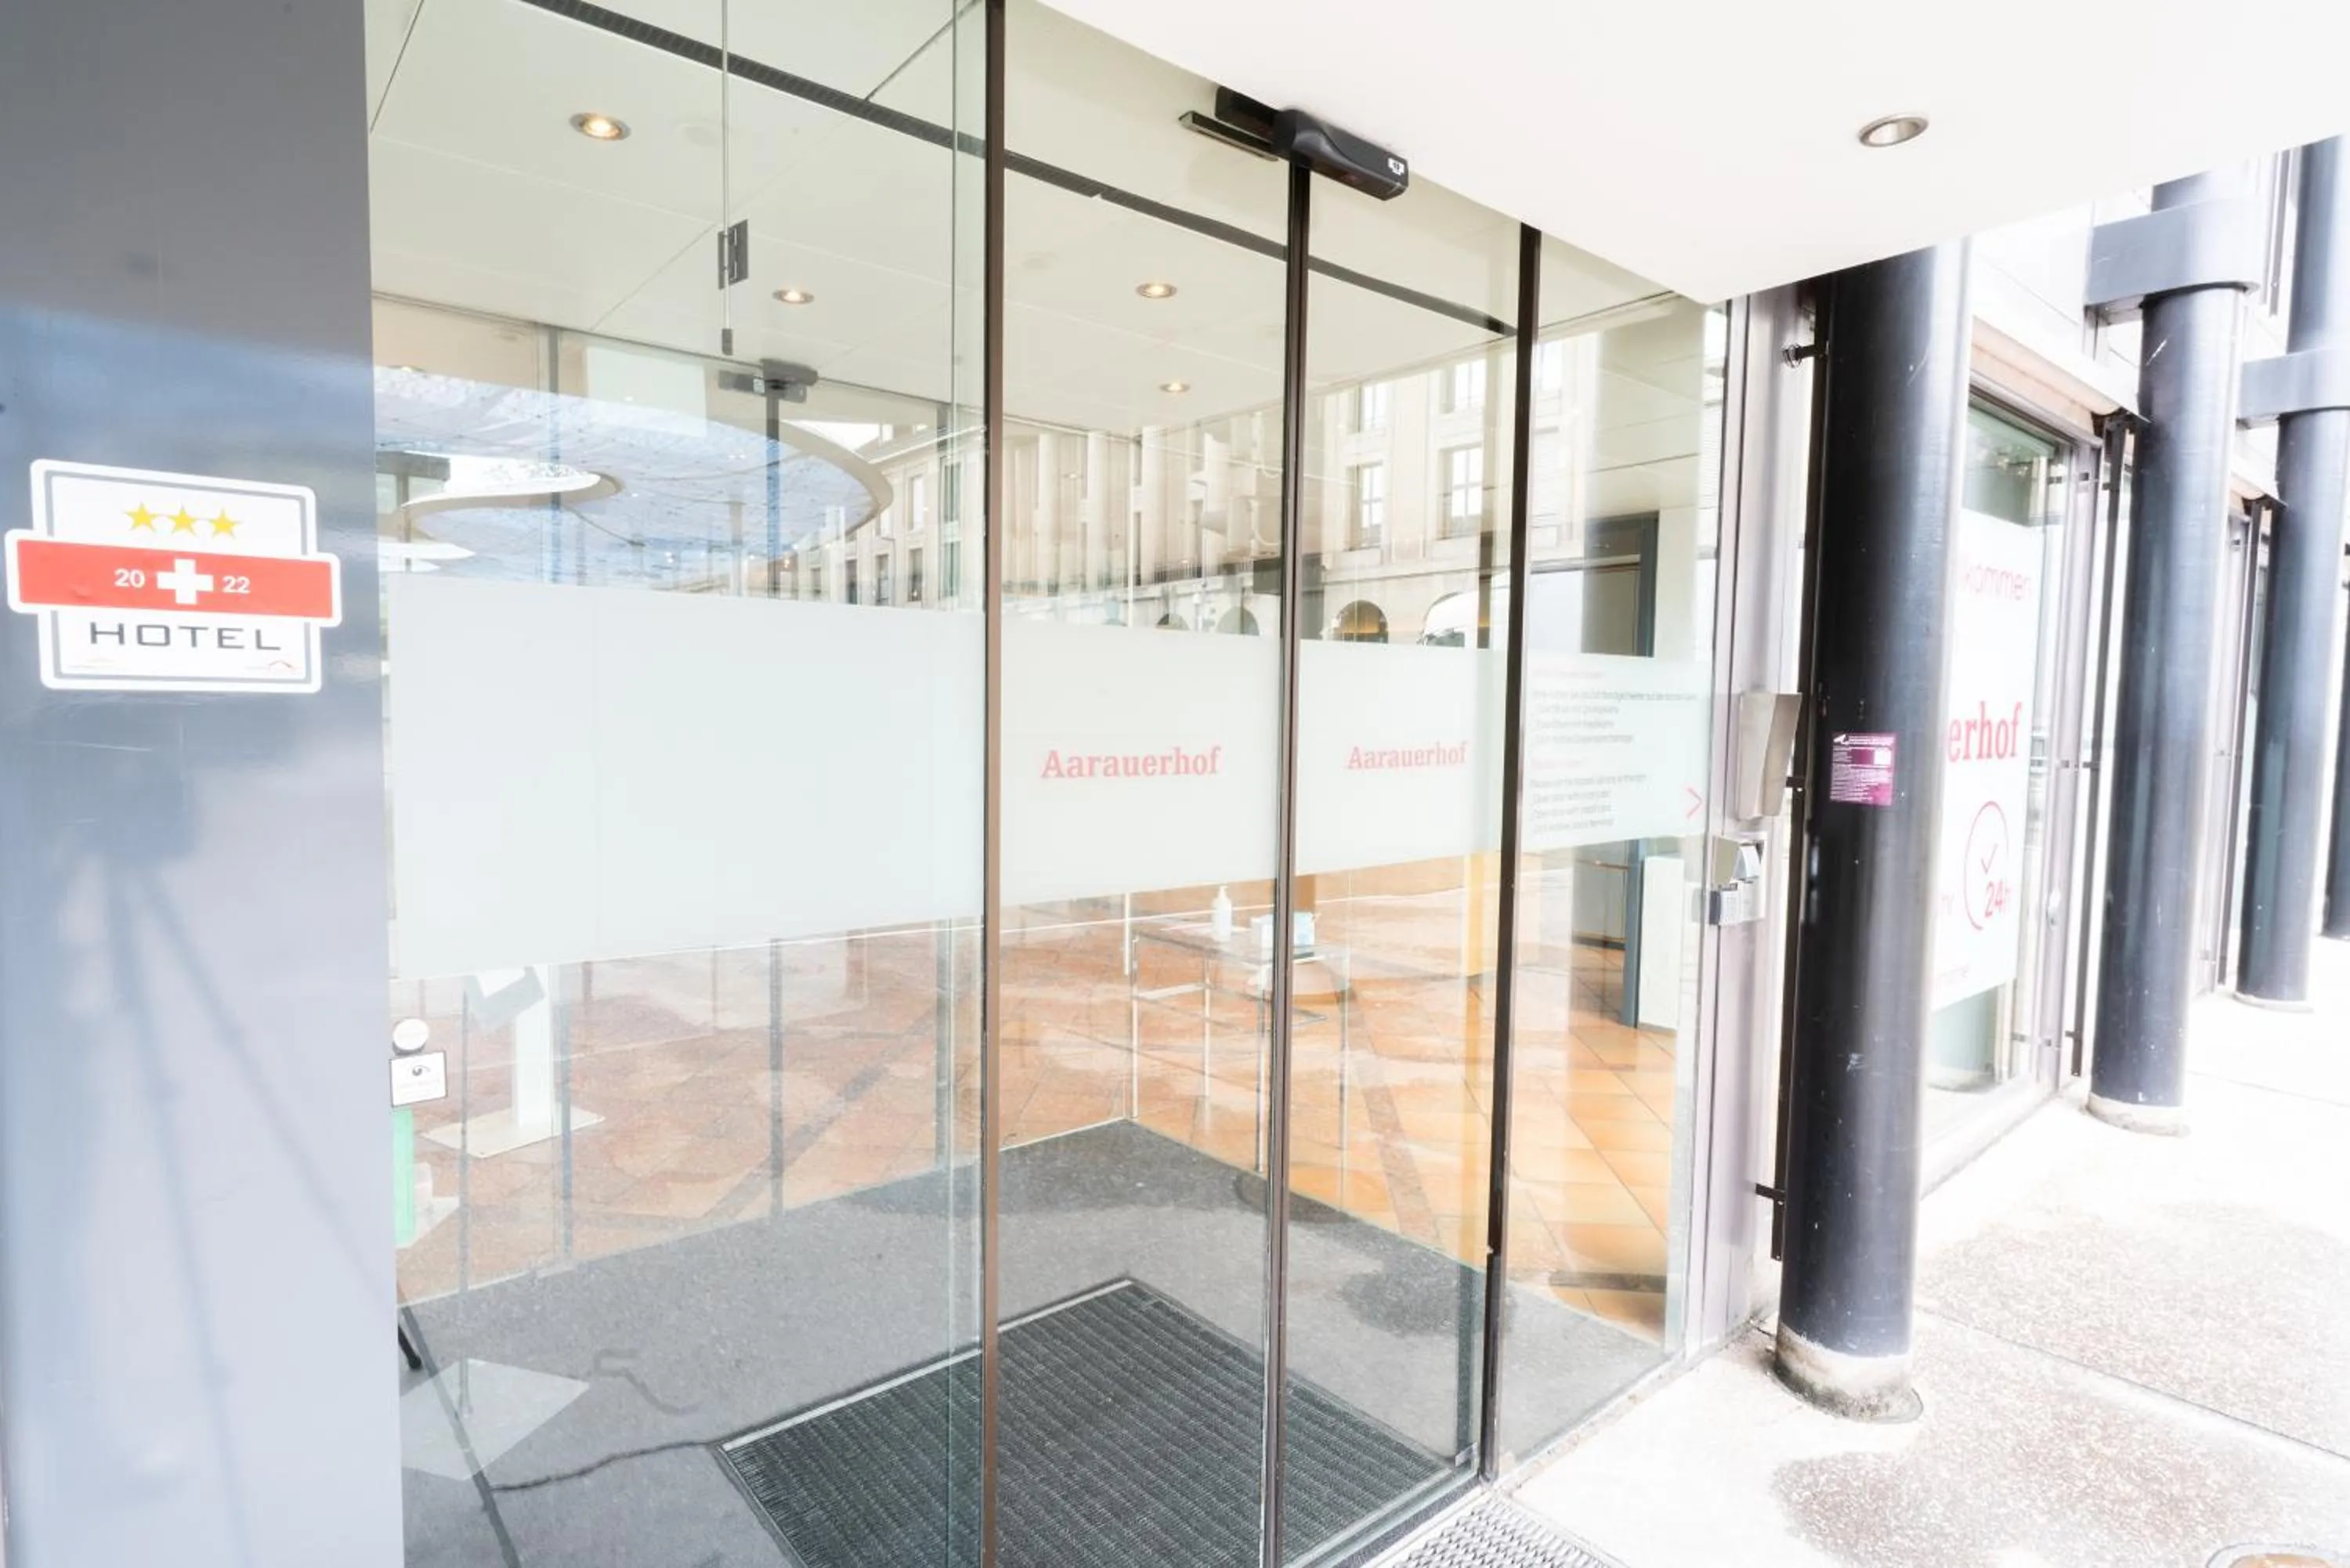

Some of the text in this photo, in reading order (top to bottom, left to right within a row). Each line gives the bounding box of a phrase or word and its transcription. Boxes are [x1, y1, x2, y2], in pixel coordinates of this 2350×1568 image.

[114, 569, 251, 594] 20 22
[89, 622, 281, 651] HOTEL
[1040, 745, 1222, 779] Aarauerhof
[1347, 740, 1468, 770] Aarauerhof
